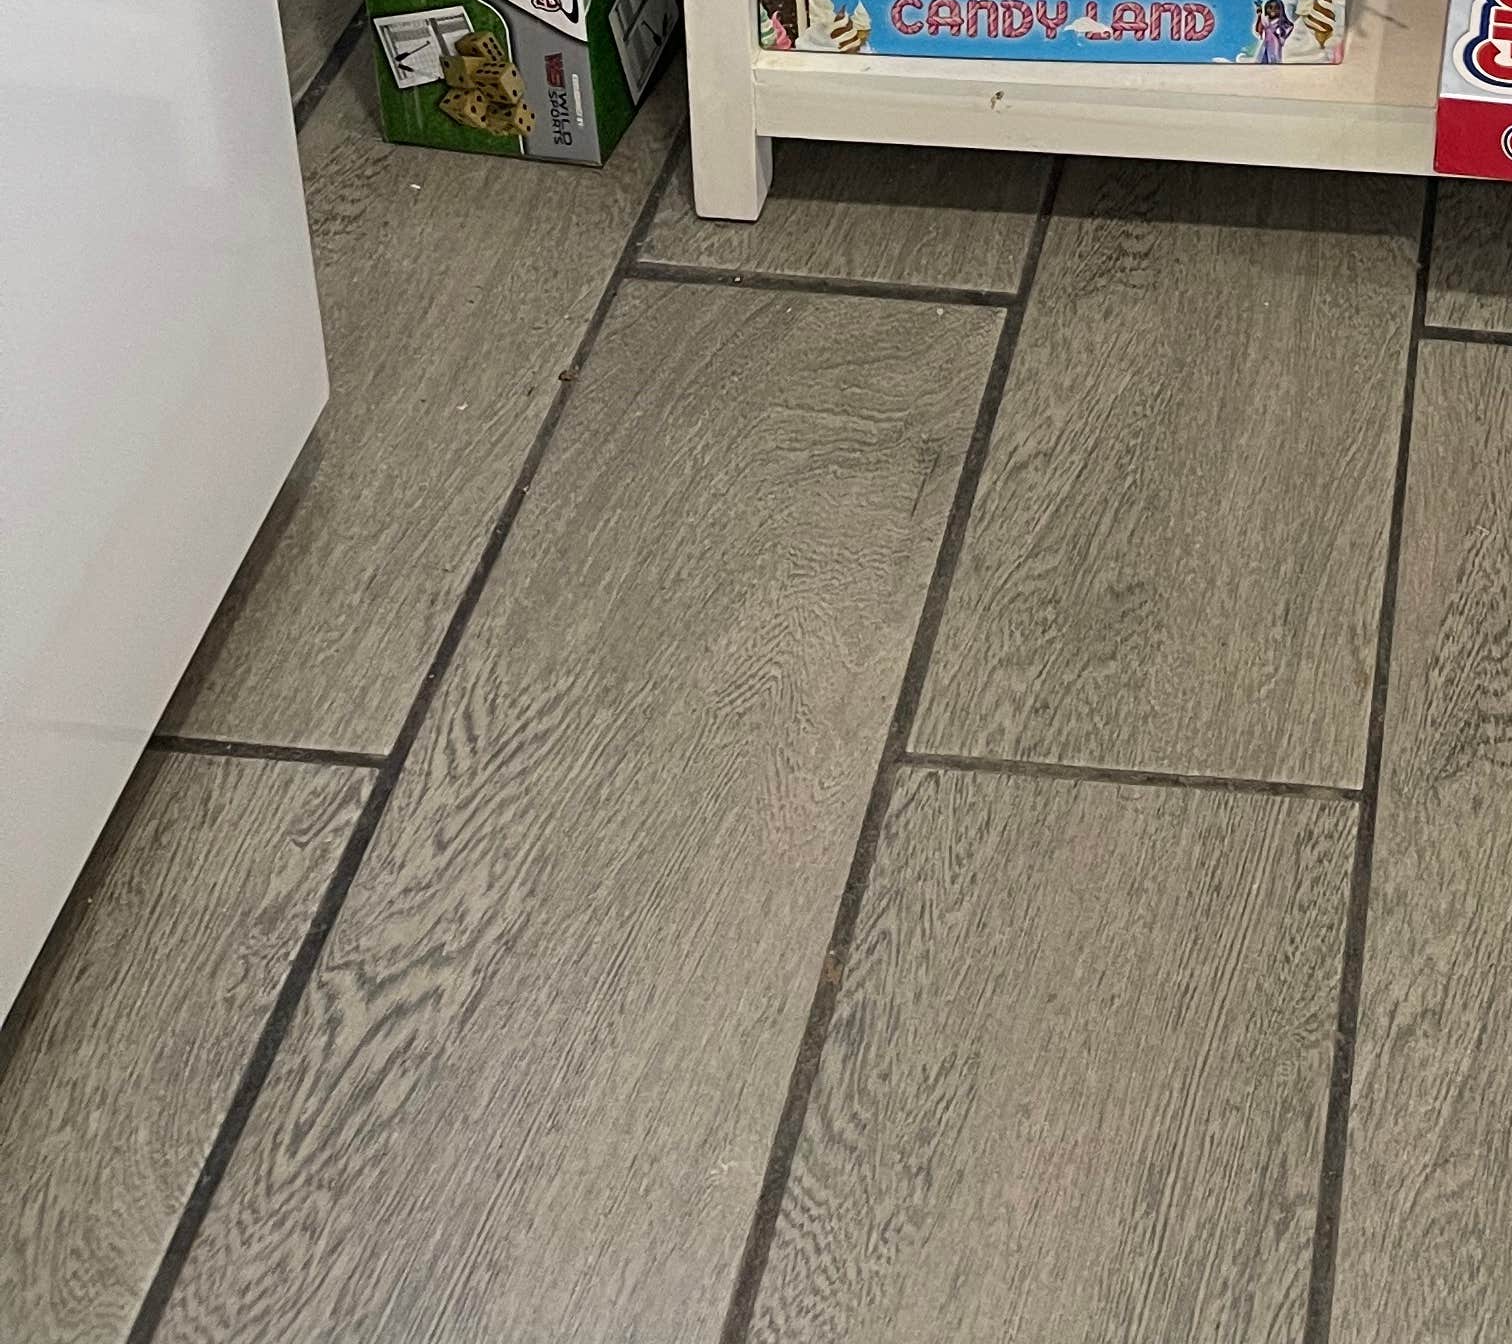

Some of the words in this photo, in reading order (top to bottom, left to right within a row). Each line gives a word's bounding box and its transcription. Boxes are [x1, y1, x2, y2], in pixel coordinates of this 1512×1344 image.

[1084, 0, 1217, 42] LAND
[547, 89, 563, 145] SPORTS
[557, 88, 573, 146] WILD
